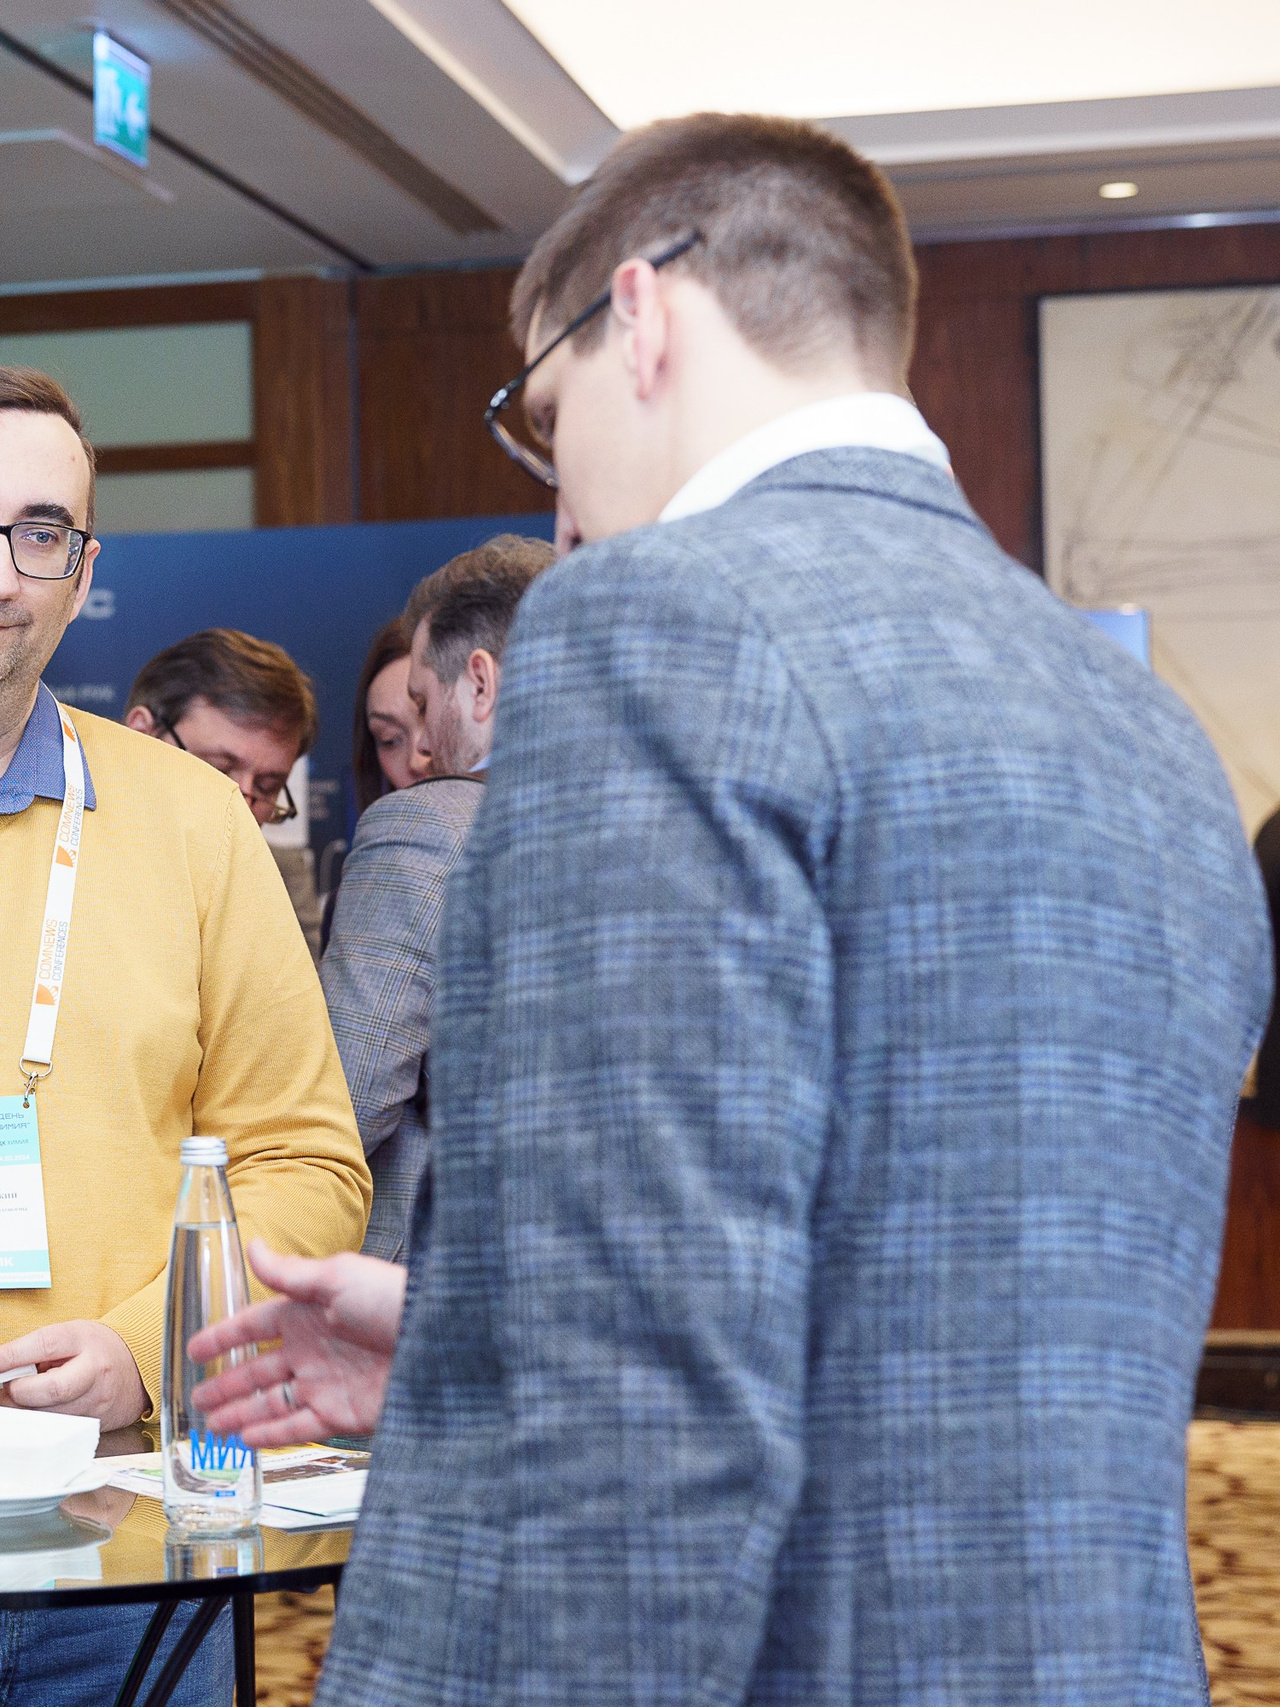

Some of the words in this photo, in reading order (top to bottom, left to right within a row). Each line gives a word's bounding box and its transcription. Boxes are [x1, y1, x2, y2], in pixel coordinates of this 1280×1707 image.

[59, 783, 75, 843] COMNEWS
[70, 787, 83, 847] CONFERENCES
[39, 919, 58, 980] COMNEWS
[52, 921, 68, 981] CONFERENCES
